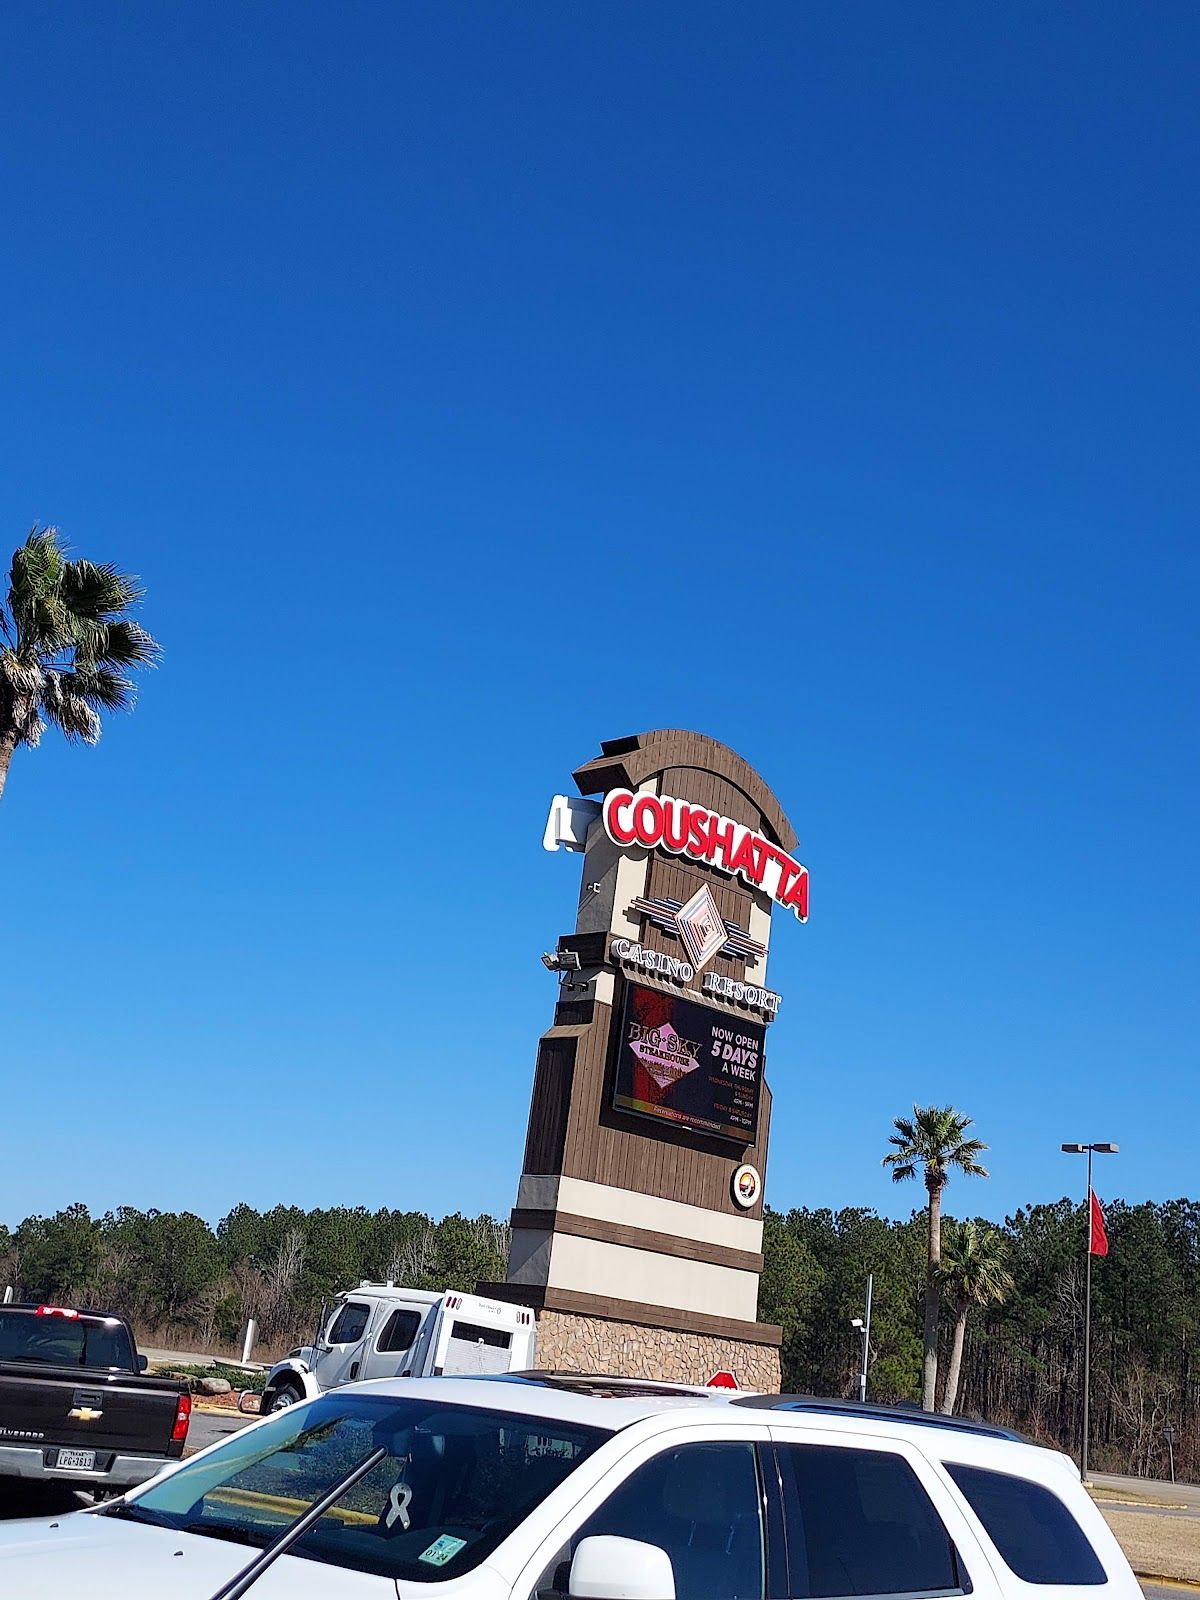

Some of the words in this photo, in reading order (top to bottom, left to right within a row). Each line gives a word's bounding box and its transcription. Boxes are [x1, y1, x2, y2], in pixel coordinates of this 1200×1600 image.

[606, 793, 809, 919] COUSHATTA
[611, 939, 694, 982] CASINO
[704, 972, 782, 1014] RESORT
[628, 1021, 661, 1048] BIG
[667, 1033, 703, 1059] SKY
[711, 1026, 734, 1042] NOW
[735, 1034, 759, 1051] OPEN
[639, 1044, 690, 1066] STEAKHOUSE
[711, 1040, 722, 1057] 5
[721, 1043, 759, 1069] DAYS
[721, 1061, 729, 1074] A
[730, 1064, 756, 1082] WEEK
[0, 1427, 45, 1439] ILVERADO
